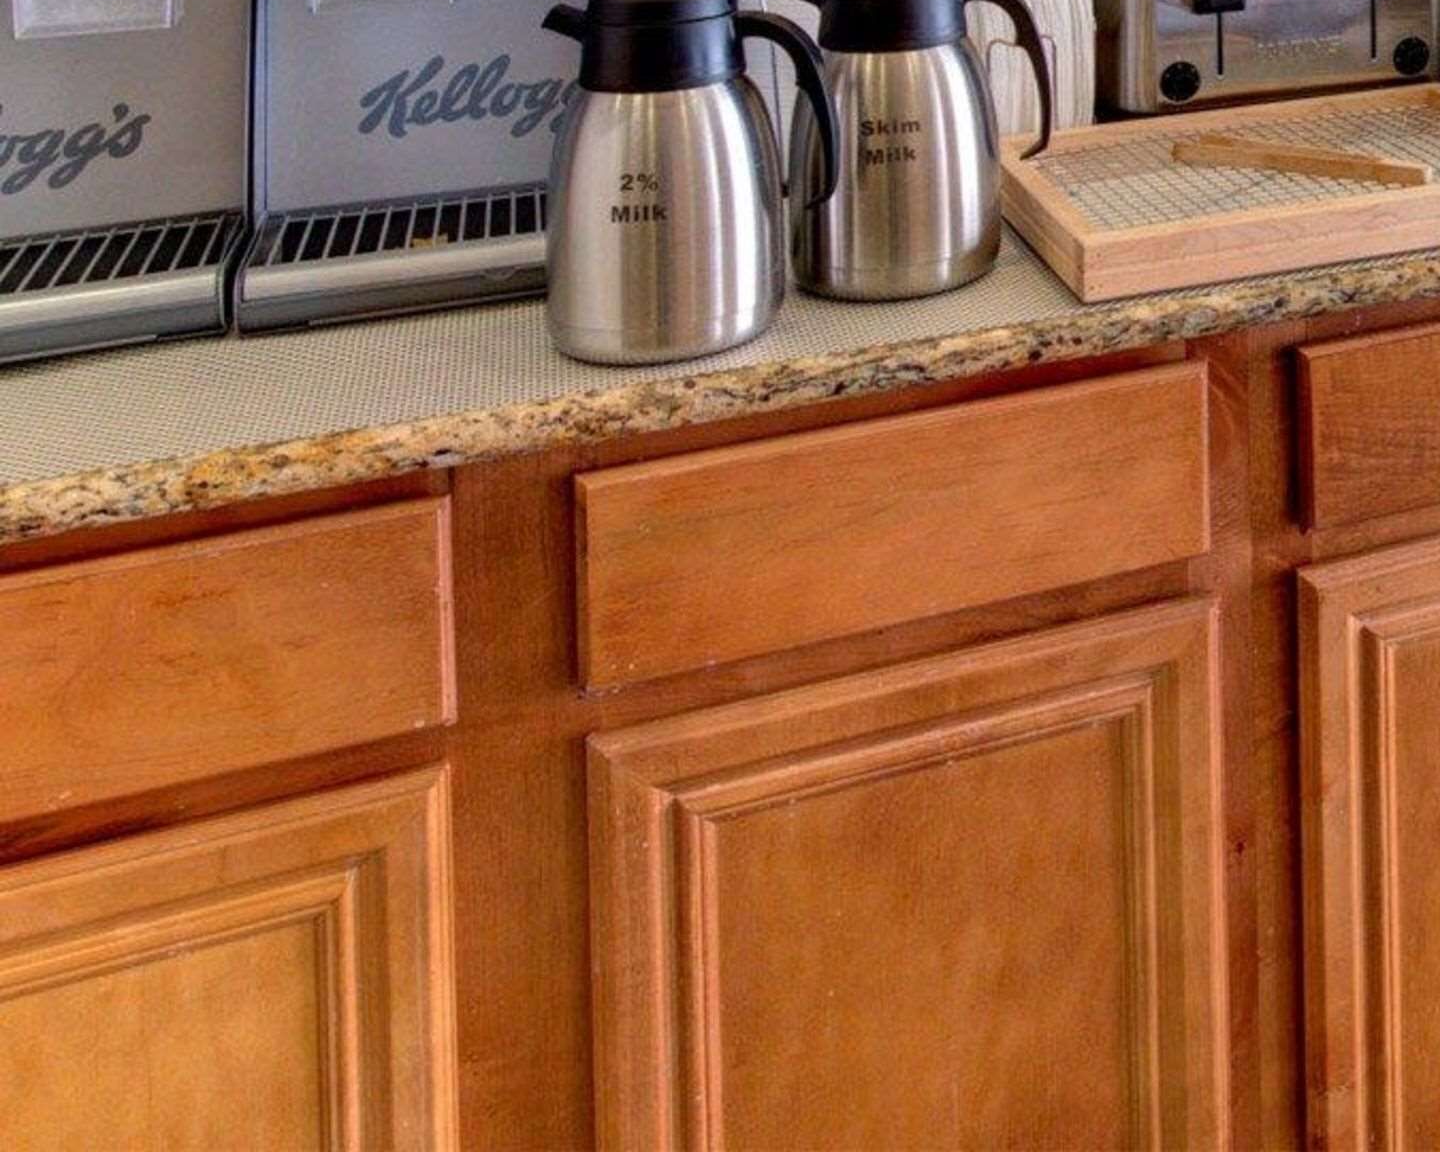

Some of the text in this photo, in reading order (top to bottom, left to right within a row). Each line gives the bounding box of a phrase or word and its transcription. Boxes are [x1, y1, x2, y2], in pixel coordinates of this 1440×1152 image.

[861, 119, 921, 137] Skim
[0, 102, 152, 195] ogg's
[864, 146, 917, 167] Milk
[619, 172, 659, 194] 2%
[610, 202, 668, 225] Milk
